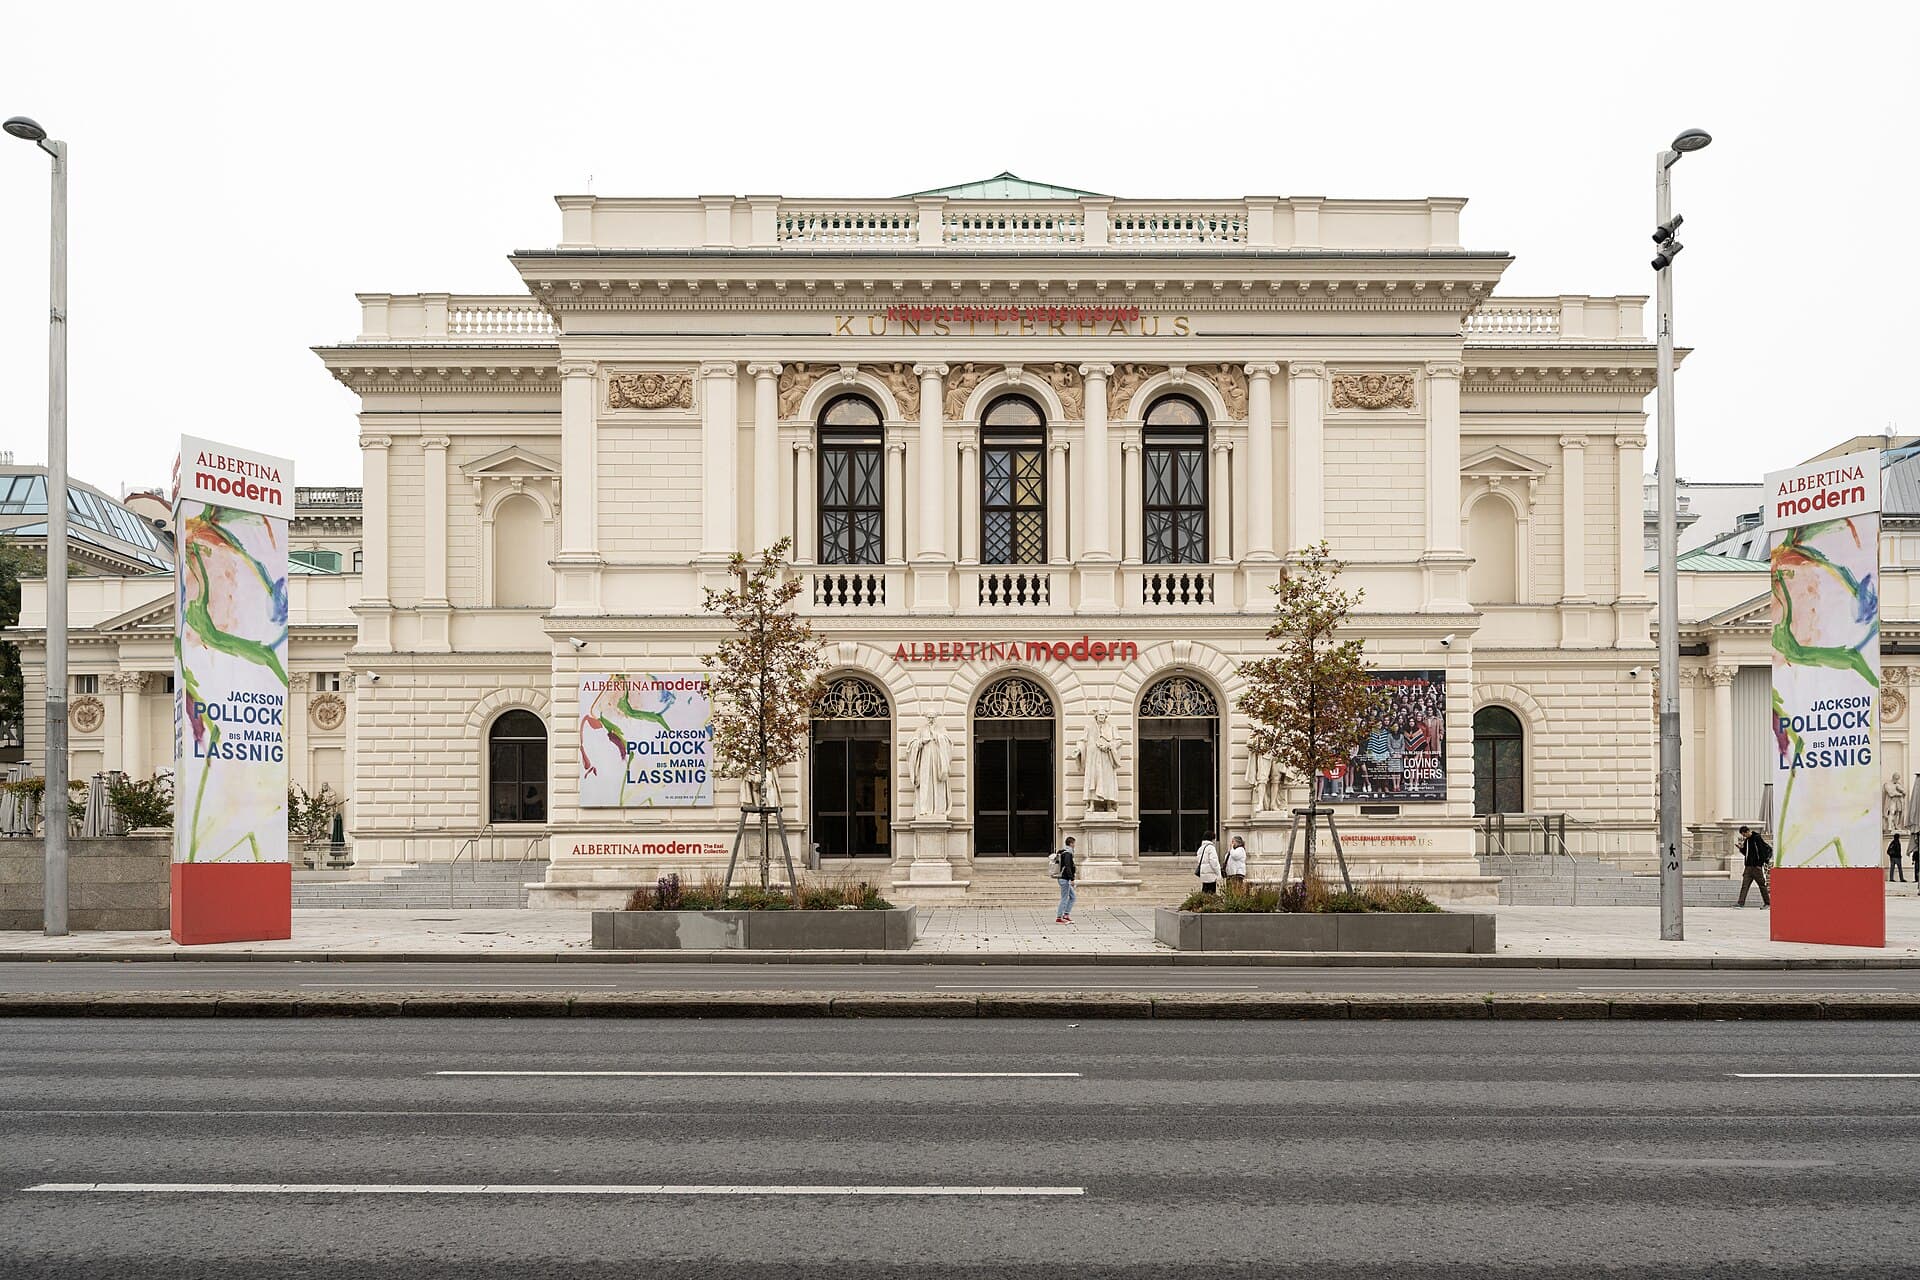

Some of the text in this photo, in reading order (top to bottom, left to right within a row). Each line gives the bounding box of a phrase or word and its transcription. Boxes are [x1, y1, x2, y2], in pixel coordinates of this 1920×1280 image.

[887, 304, 1139, 322] KÜNSTLERHAUS VEREINIGUNG
[834, 313, 1190, 336] KÜNSTLERHAUS
[196, 451, 281, 483] ALBERTINA
[1777, 465, 1865, 496] ALBERTINA
[196, 472, 282, 506] modern
[1777, 486, 1865, 518] modern
[893, 636, 1138, 661] ALBERTINA modern
[583, 681, 649, 691] ALBERTINA
[227, 691, 283, 706] JACKSON
[1811, 696, 1870, 712] JACKSON
[194, 701, 283, 726] POLLOCK
[1778, 710, 1870, 734] POLLOCK
[243, 730, 283, 743] MARIA
[655, 730, 706, 739] JACKSON
[1828, 734, 1871, 747] MARIA
[194, 740, 283, 762] LASSNIG
[626, 741, 705, 755] POLLOCK
[669, 759, 705, 768] MARIA
[1403, 757, 1439, 769] LOVING
[1779, 747, 1871, 770] LASSNIG
[626, 770, 706, 784] LASSNIG
[1403, 768, 1443, 780] OTHERS
[572, 841, 702, 855] ALBERTINA modern
